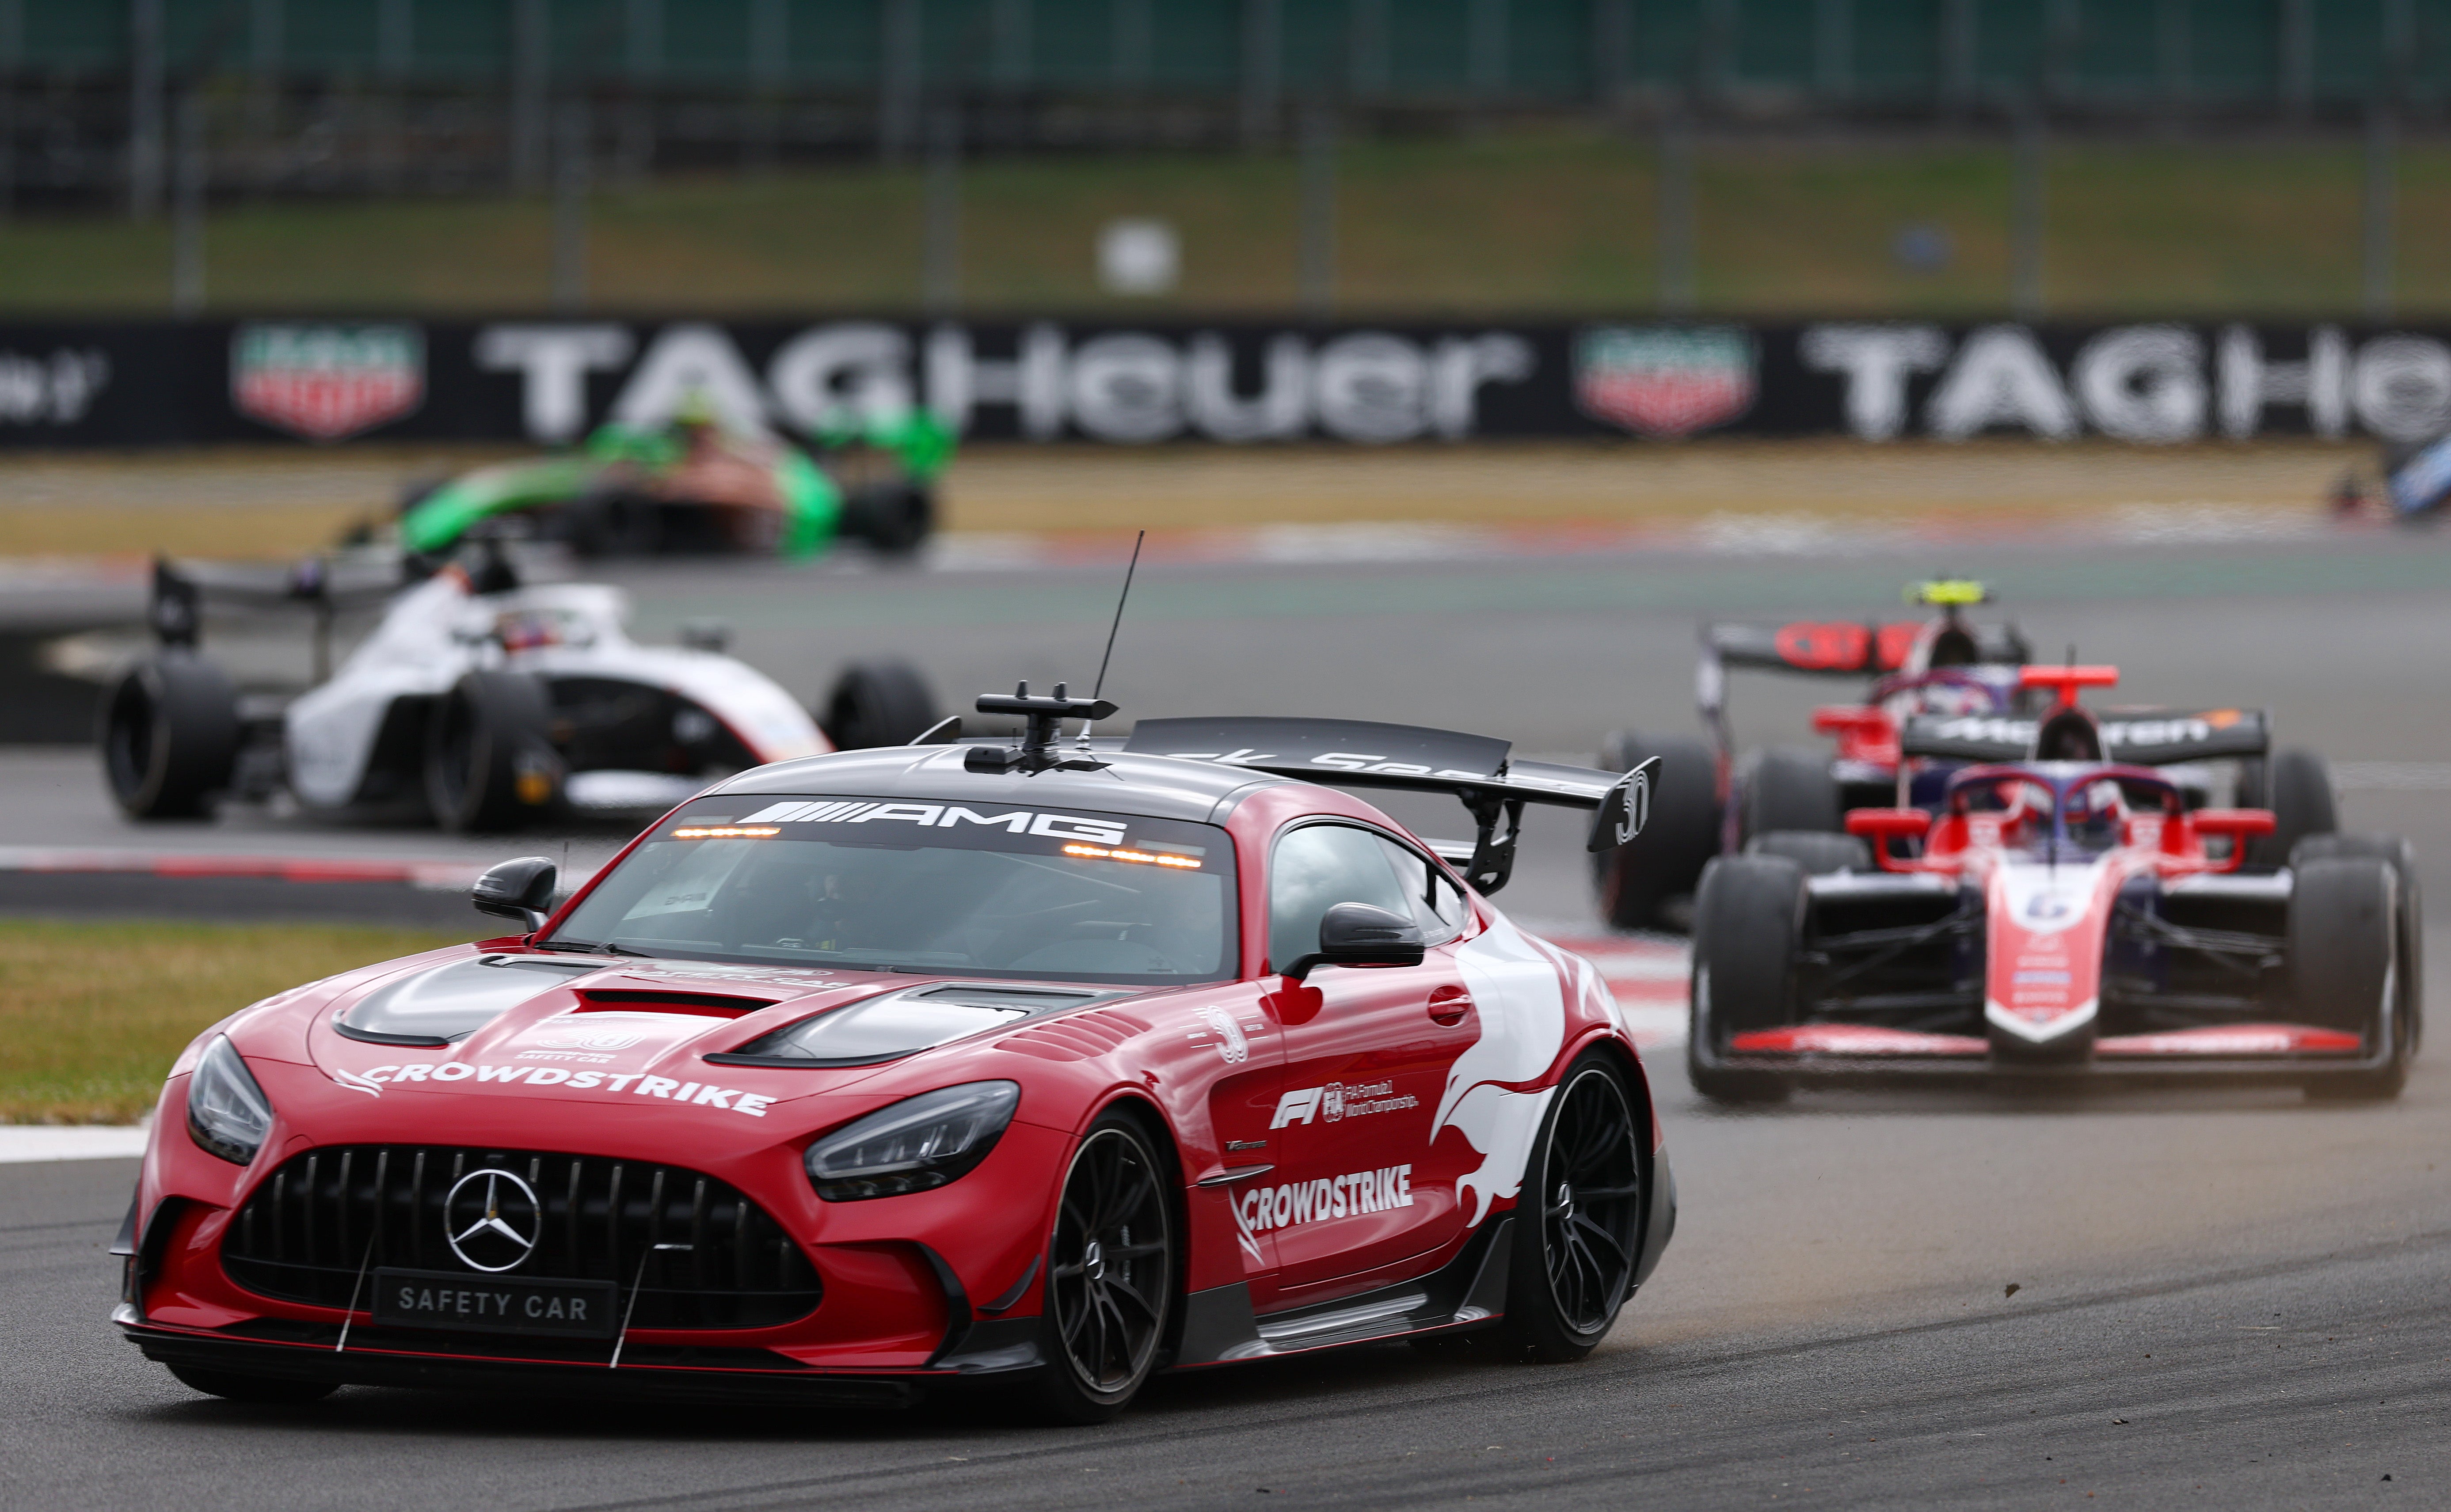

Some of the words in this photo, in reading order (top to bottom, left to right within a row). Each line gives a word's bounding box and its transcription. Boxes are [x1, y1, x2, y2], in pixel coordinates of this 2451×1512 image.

[846, 803, 1127, 845] AMG
[618, 970, 770, 979] SAFETY
[773, 977, 853, 987] CAR
[361, 1061, 777, 1117] CROWDSTRIKE
[1269, 1087, 1325, 1129] F1
[1241, 1163, 1413, 1231] CROWDSTRIKE
[399, 1287, 511, 1315] SAFETY
[525, 1295, 587, 1321] CAR
